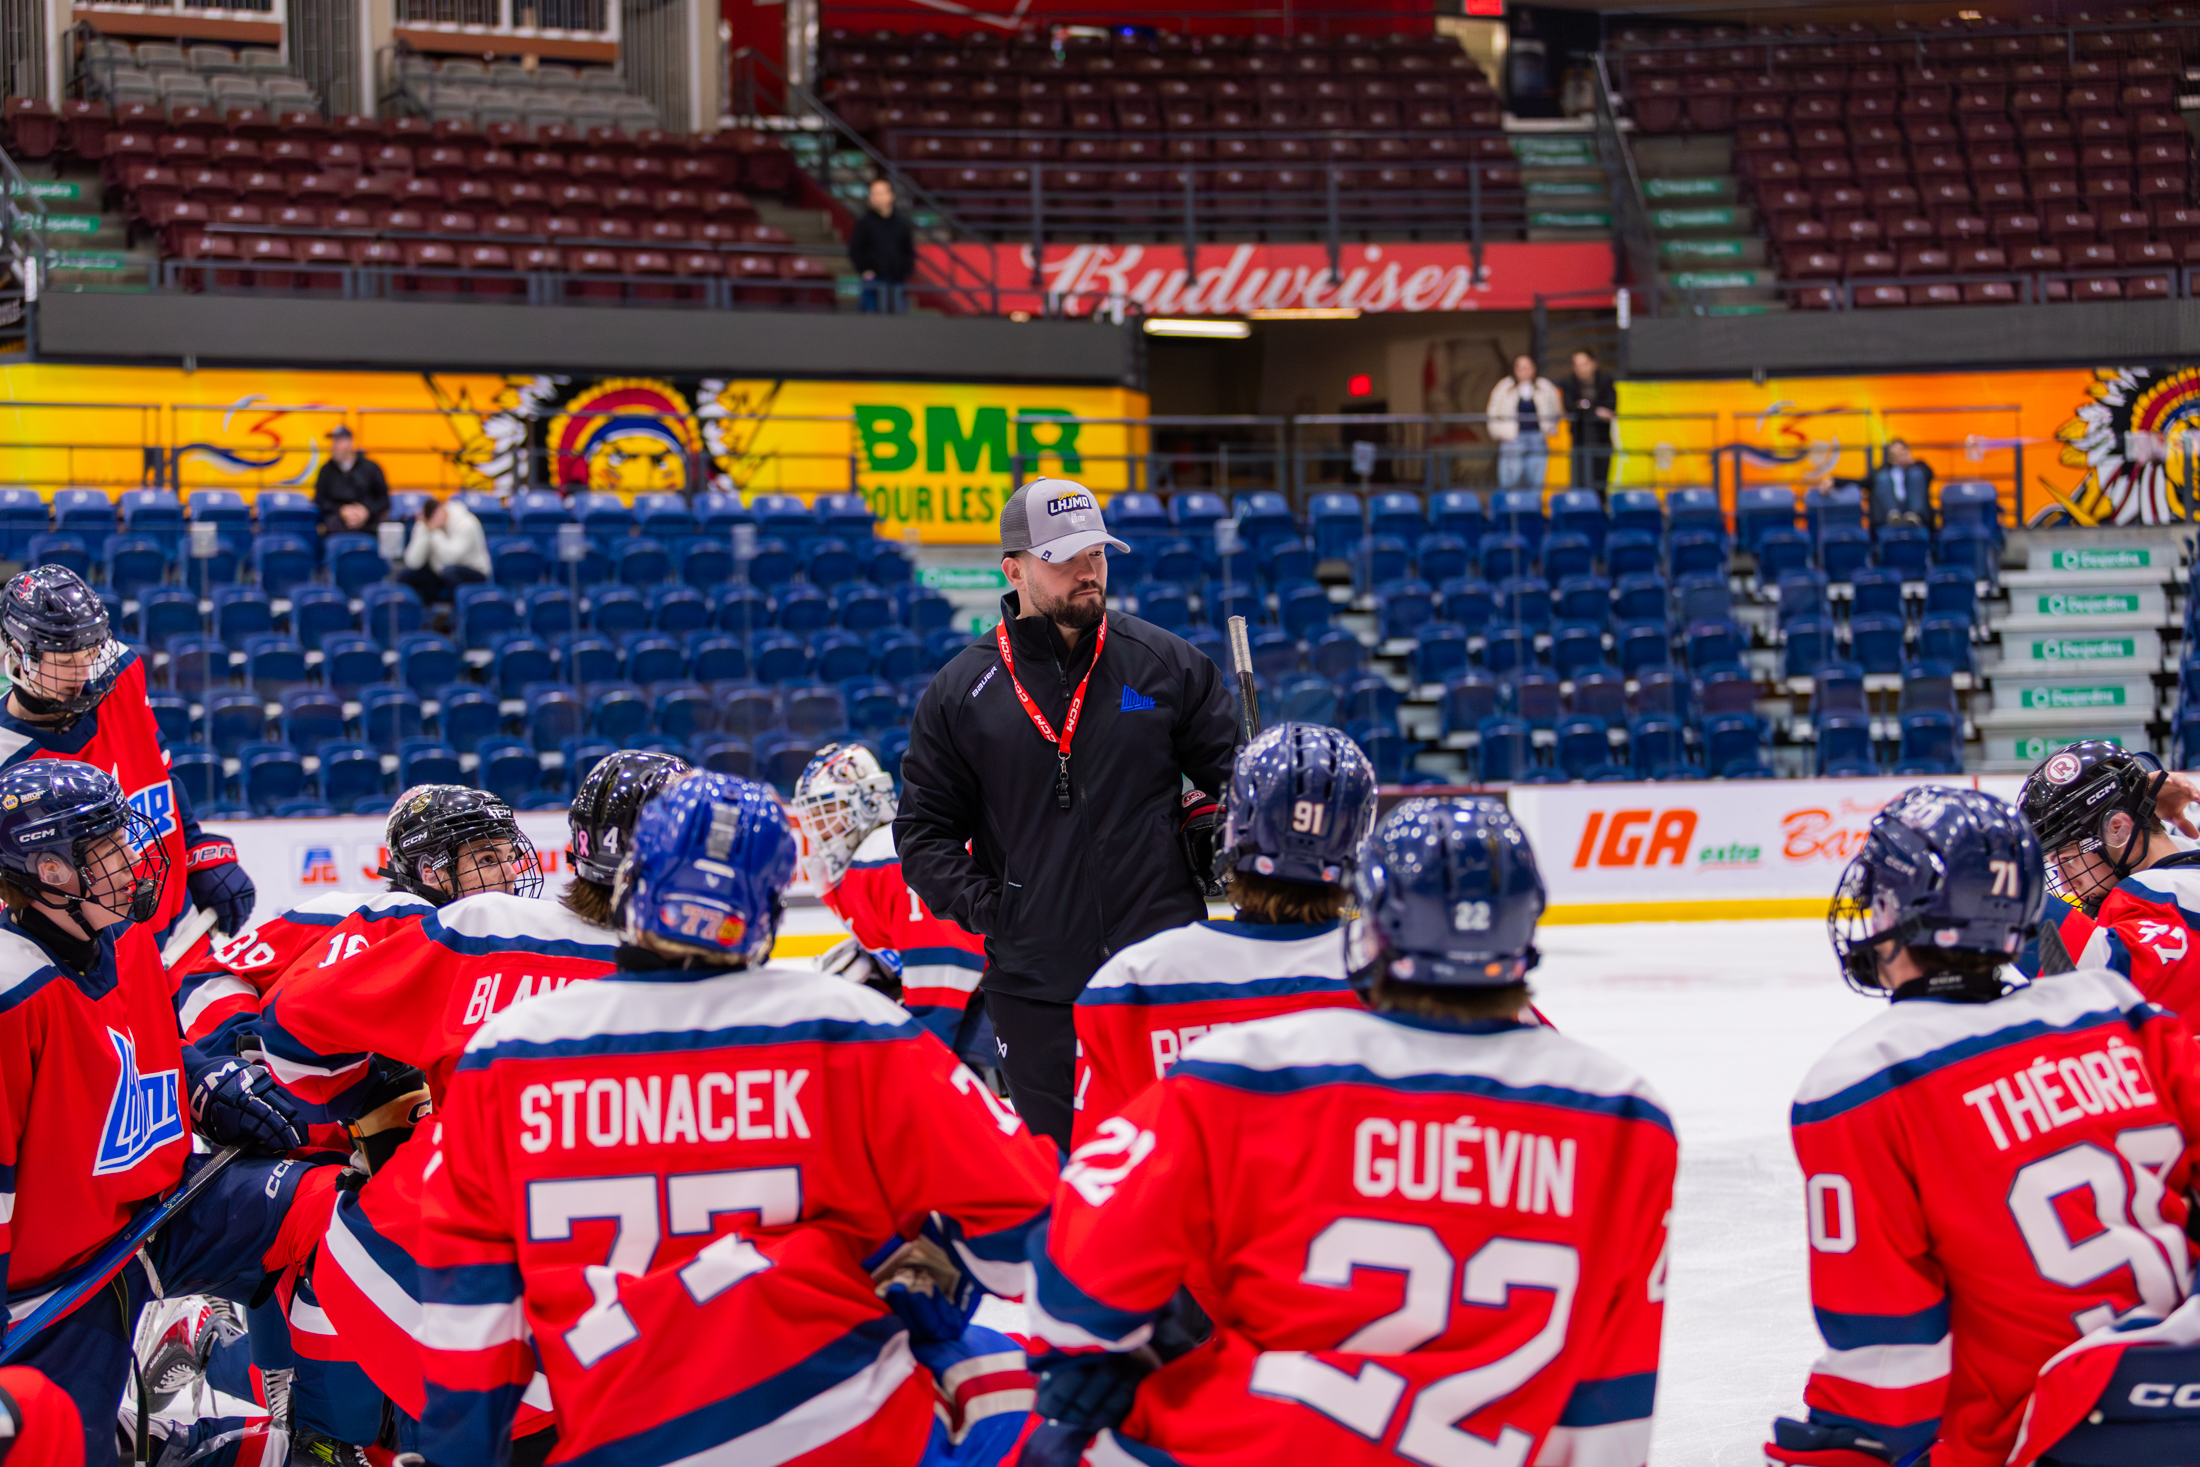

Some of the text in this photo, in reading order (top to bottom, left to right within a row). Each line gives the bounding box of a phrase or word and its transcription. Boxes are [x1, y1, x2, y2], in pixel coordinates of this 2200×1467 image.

[1021, 244, 1486, 317] Budweiser
[854, 404, 1082, 473] BMR
[943, 486, 994, 523] LES
[1049, 496, 1090, 514] LHJMQ
[999, 635, 1012, 663] CCM
[1066, 697, 1081, 733] CCM
[2052, 760, 2073, 777] R
[2086, 781, 2117, 806] CCM
[1292, 800, 1325, 835] 91
[18, 828, 56, 844] CCM
[402, 830, 428, 848] CCM
[602, 826, 619, 855] 4
[1571, 808, 1762, 869] IGA extra
[186, 844, 235, 869] UER
[431, 858, 449, 872] CCM
[1988, 859, 2019, 898] 71
[681, 903, 724, 940] 77
[1453, 901, 1491, 932] 22
[213, 929, 276, 971] 39
[518, 1067, 812, 1154] STONACEK
[1352, 1115, 1578, 1219] GUÉVIN
[526, 1164, 804, 1370] 77
[1248, 1215, 1582, 1467] 22
